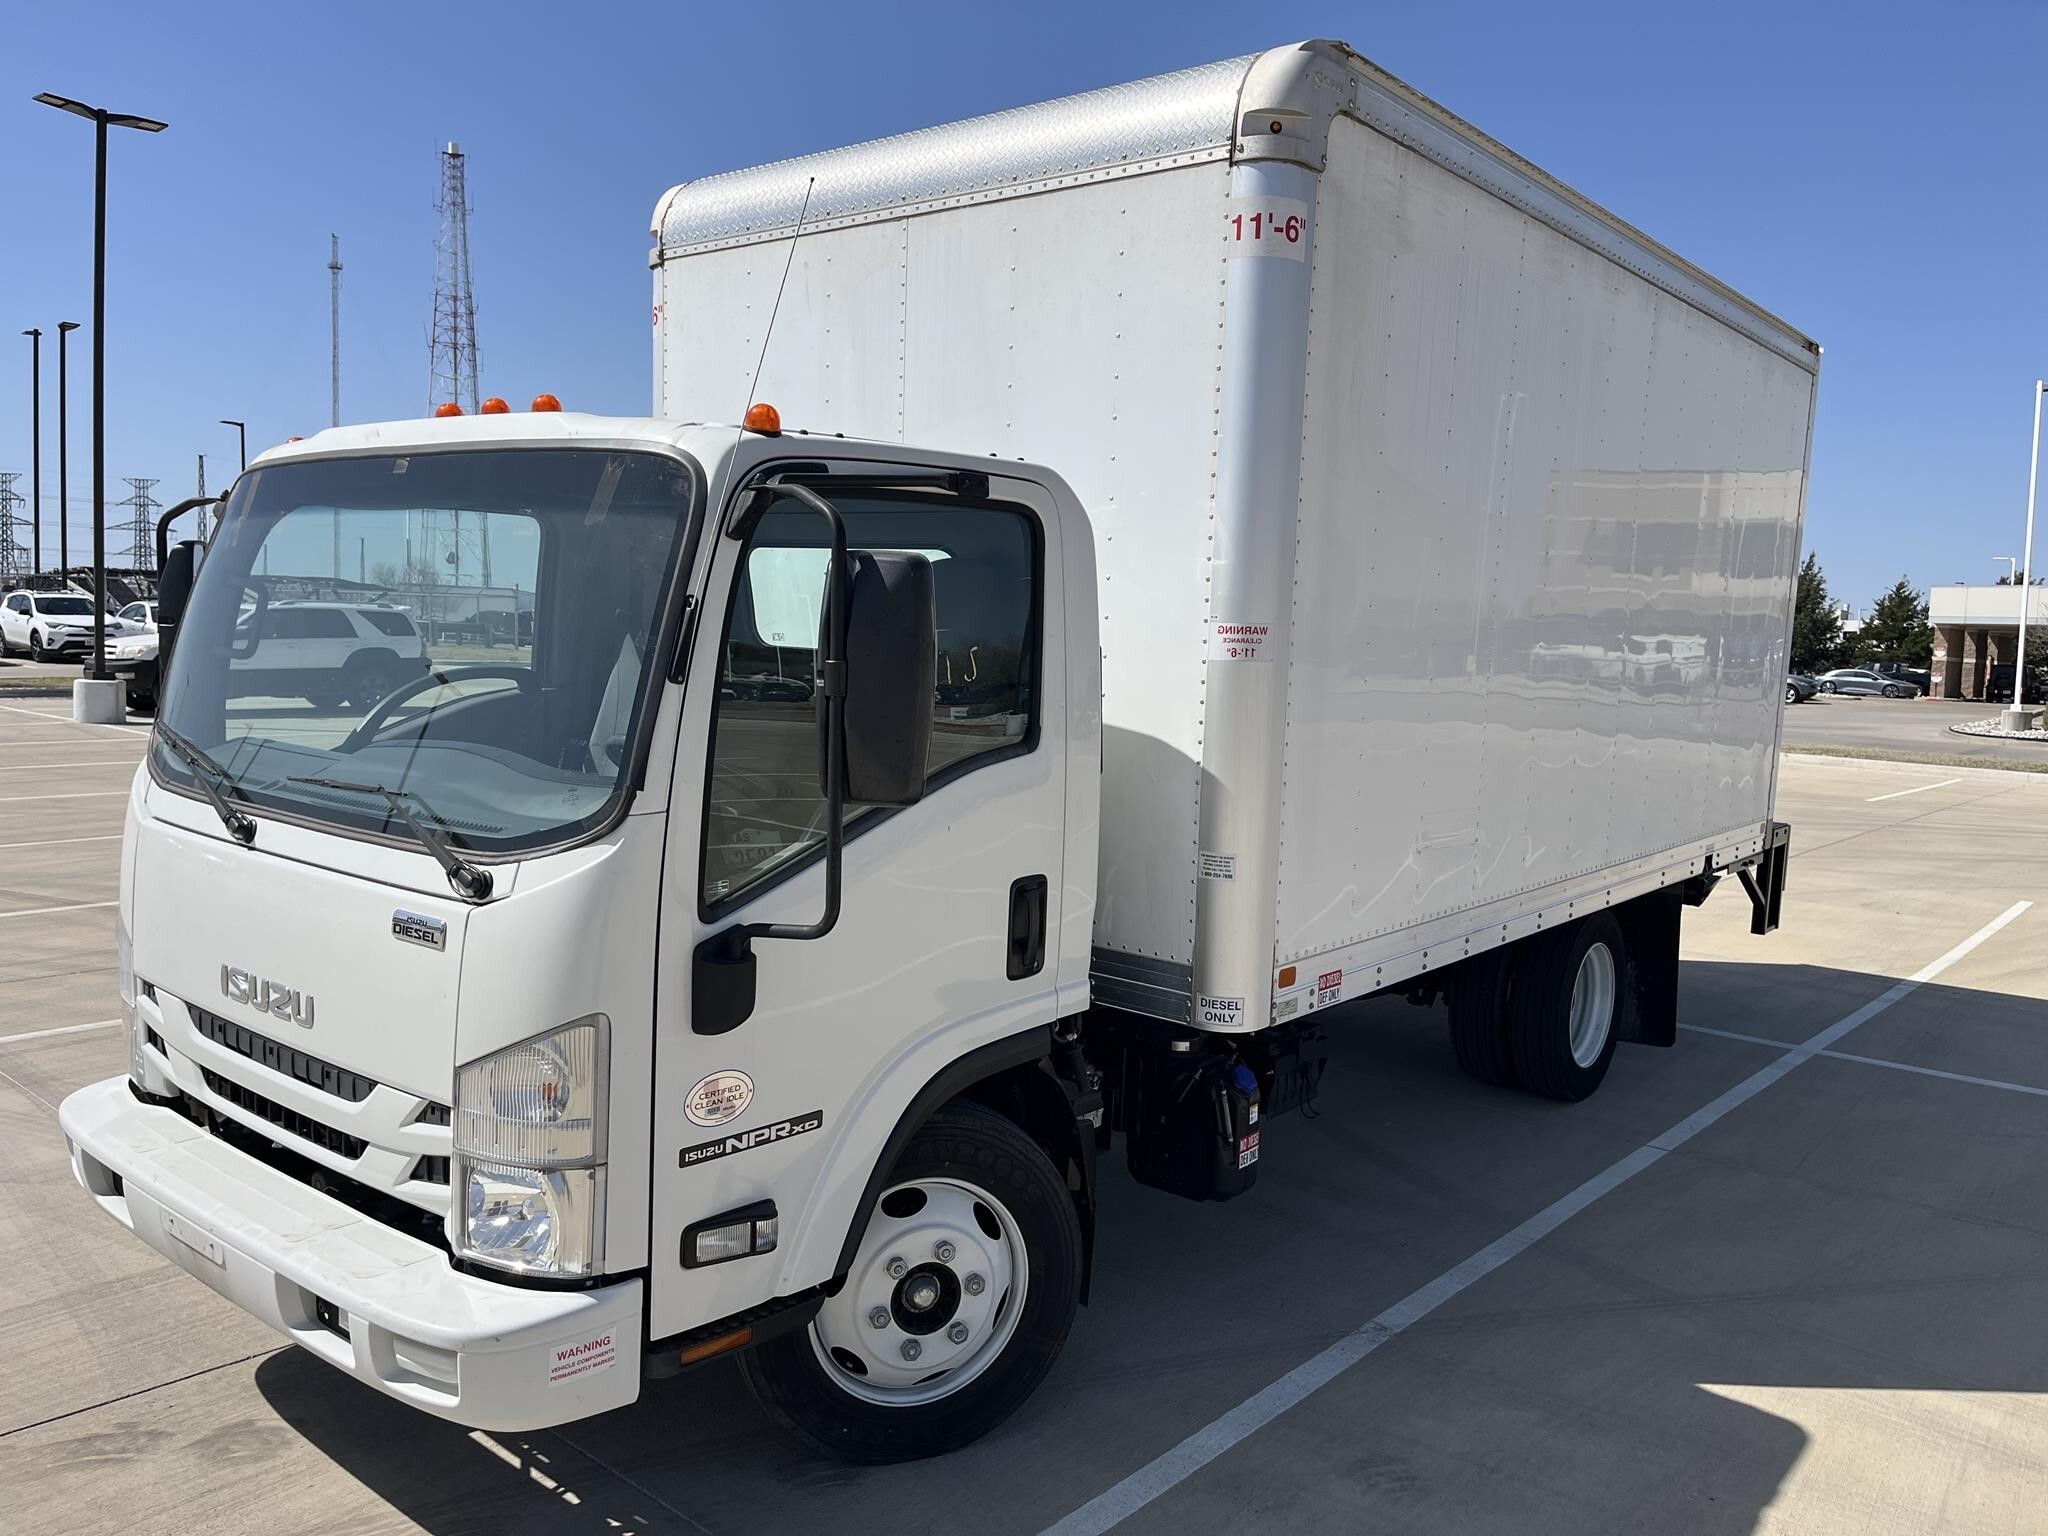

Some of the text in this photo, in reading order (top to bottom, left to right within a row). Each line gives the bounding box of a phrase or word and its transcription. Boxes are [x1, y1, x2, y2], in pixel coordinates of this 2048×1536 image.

[1231, 212, 1306, 243] 11'-6"
[406, 916, 428, 927] ISUZU
[393, 923, 438, 944] DIESEL
[220, 963, 314, 1029] ISUZU
[1200, 997, 1242, 1010] DIESEL
[1204, 1011, 1236, 1023] ONLY
[694, 1098, 724, 1110] CLEAN
[726, 1092, 745, 1102] IDLE
[699, 1084, 741, 1100] CERTIFIED
[685, 1144, 724, 1162] ISUZU
[557, 1336, 611, 1361] WARNING
[550, 1356, 616, 1382] PERMANENTLY MARKED
[551, 1348, 615, 1373] VEHICLE COMPONENTS
